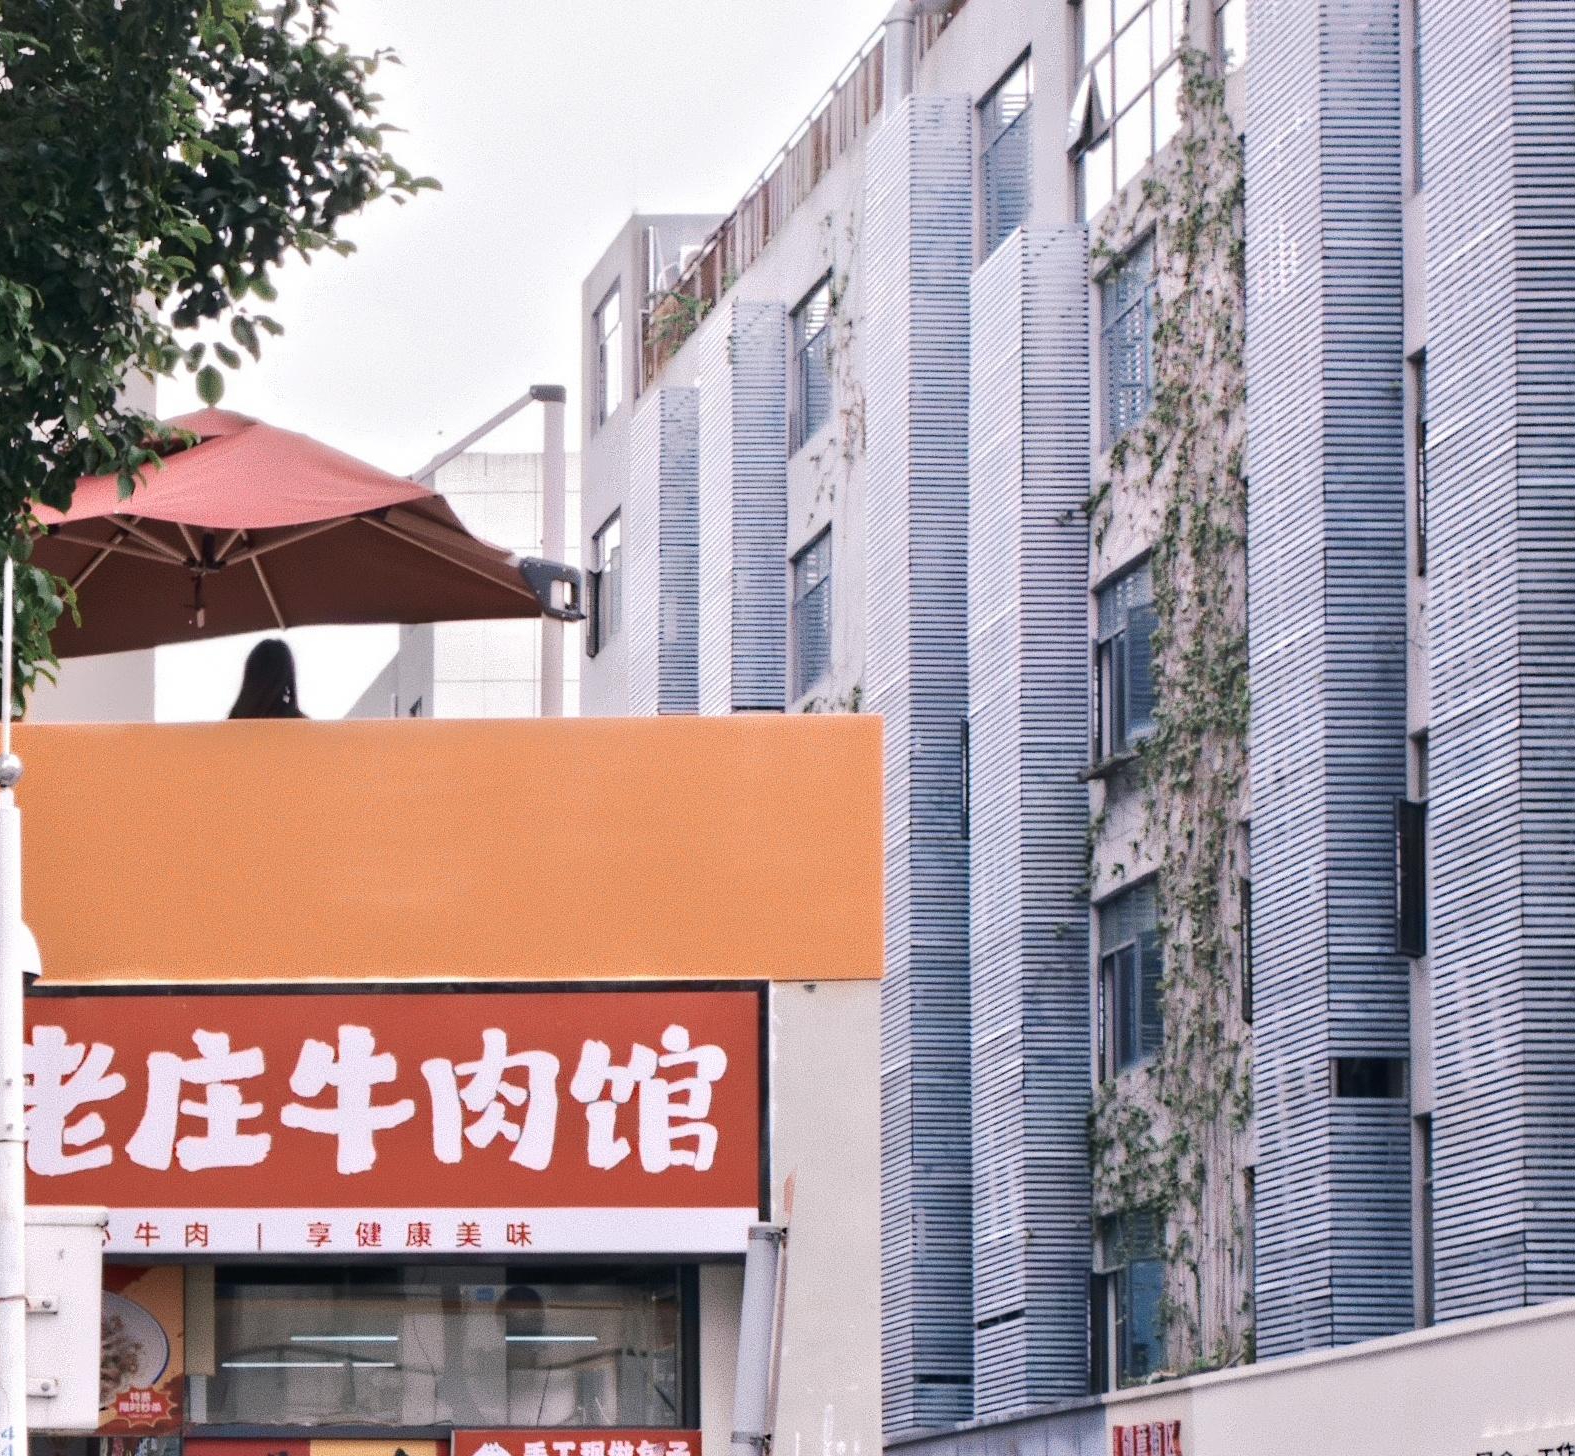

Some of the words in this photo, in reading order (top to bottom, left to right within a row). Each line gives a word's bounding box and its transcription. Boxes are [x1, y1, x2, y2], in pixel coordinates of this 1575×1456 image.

[22, 1024, 727, 1175] 老庄牛肉馆
[101, 1221, 209, 1247] 牛肉
[307, 1221, 532, 1247] 享健康美味
